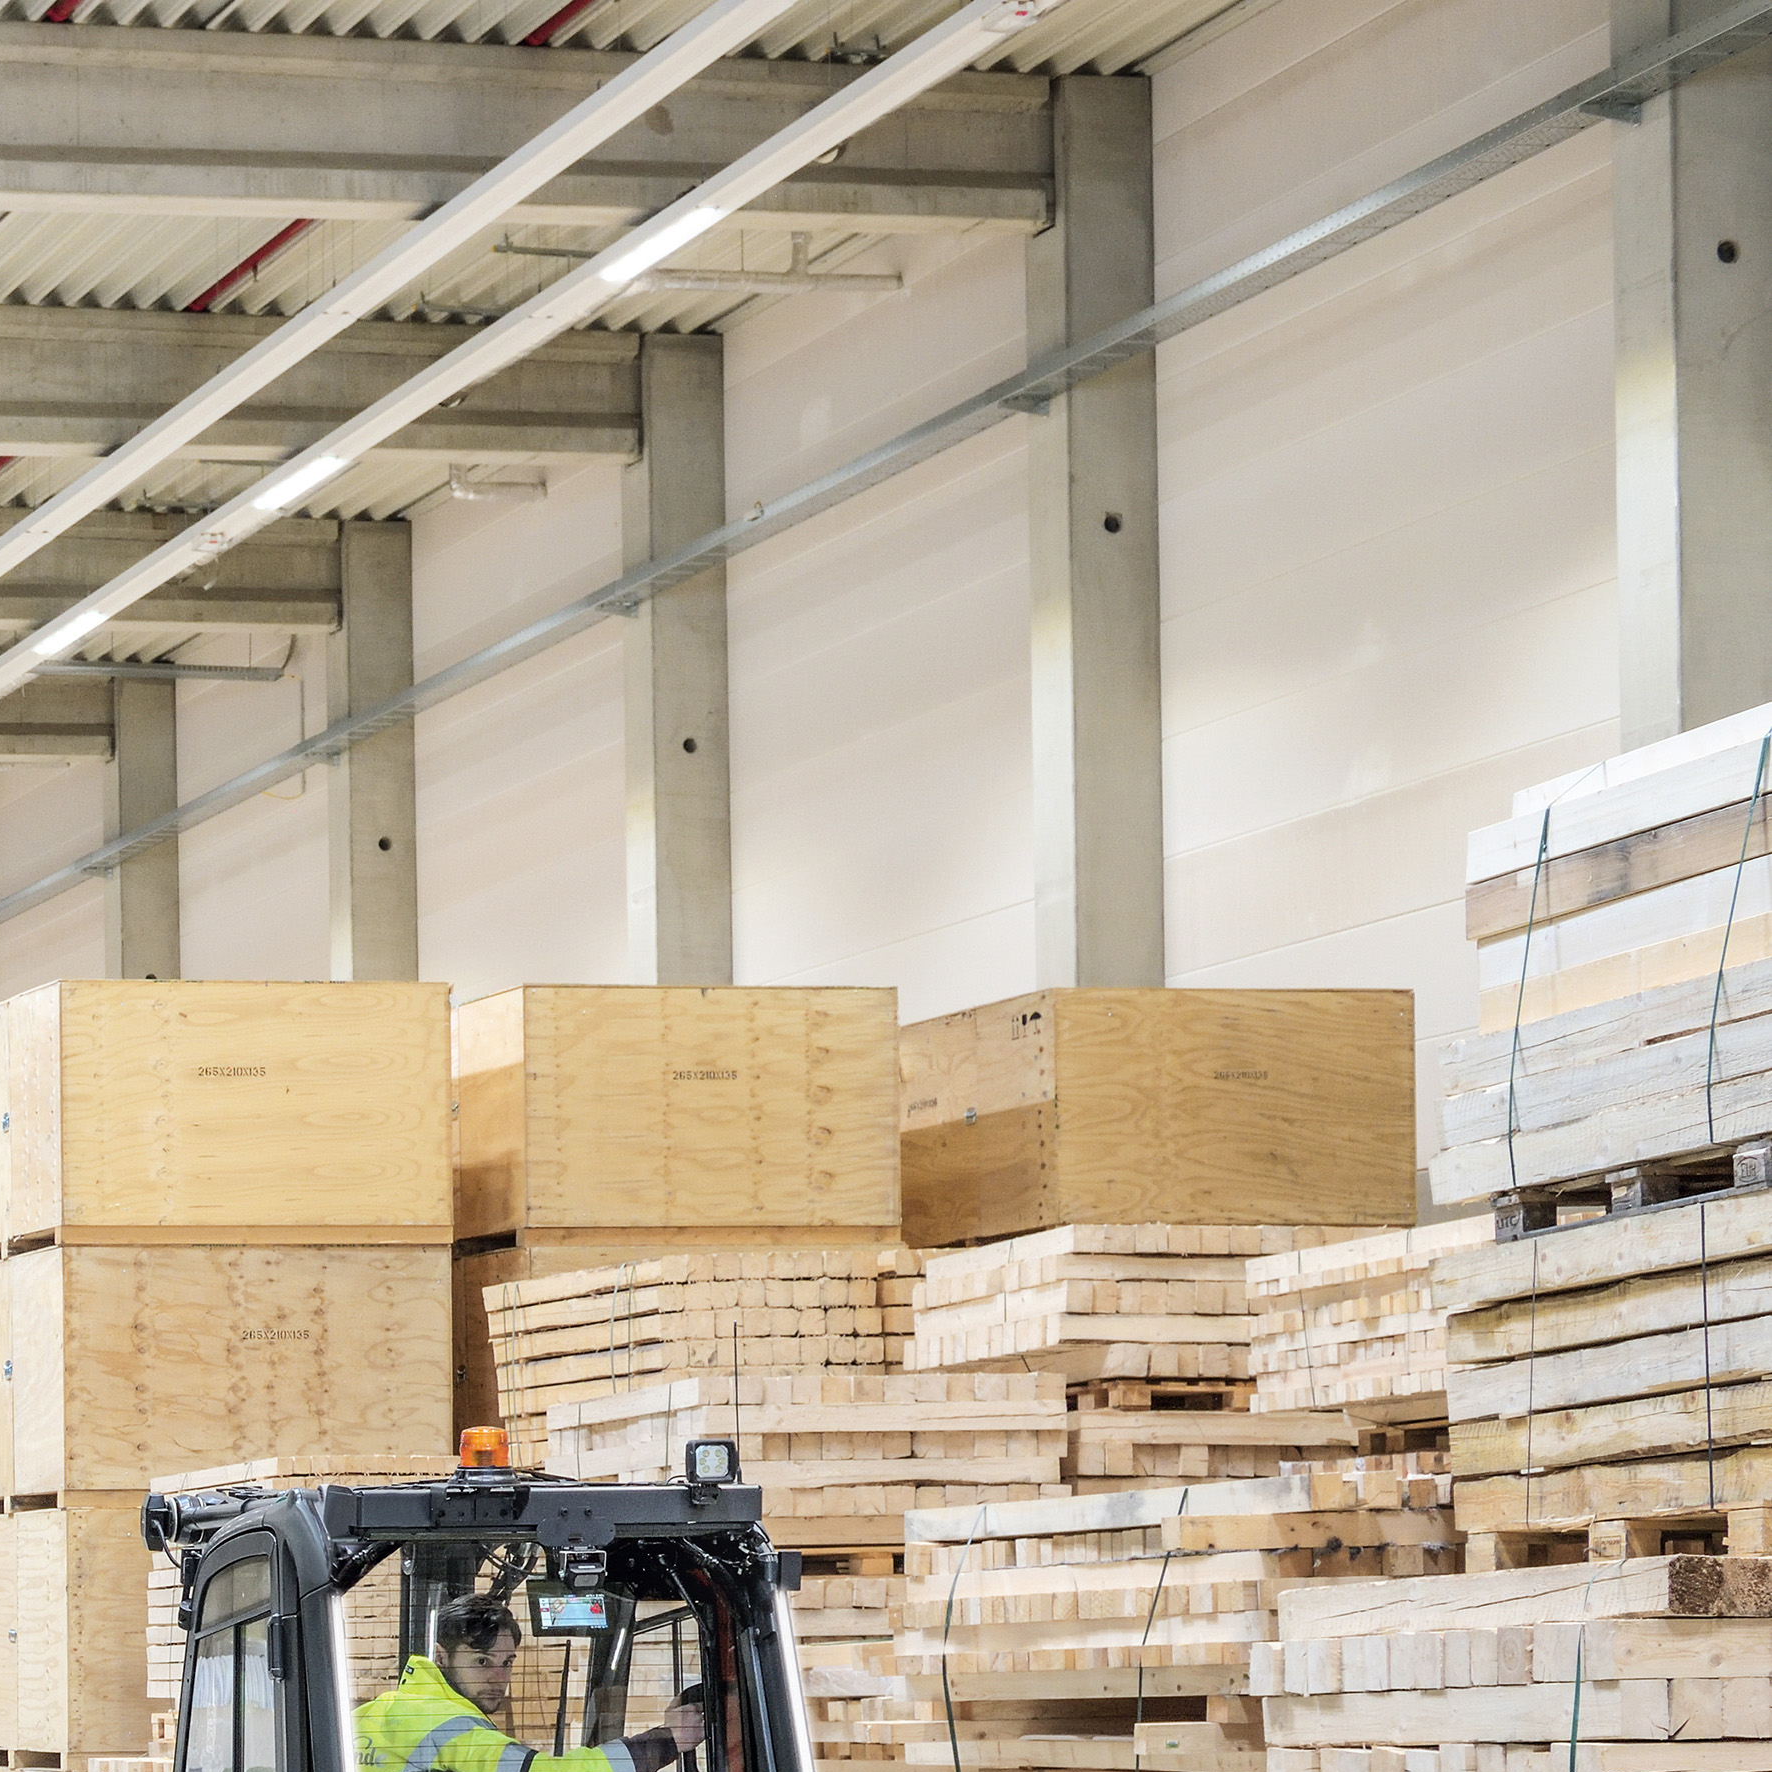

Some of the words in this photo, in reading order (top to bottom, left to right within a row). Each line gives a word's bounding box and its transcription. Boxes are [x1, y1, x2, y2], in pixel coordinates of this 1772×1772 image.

[198, 1066, 266, 1077] 265X210X135
[673, 1070, 738, 1081] 265X210X135
[242, 1329, 310, 1341] 265X210X135
